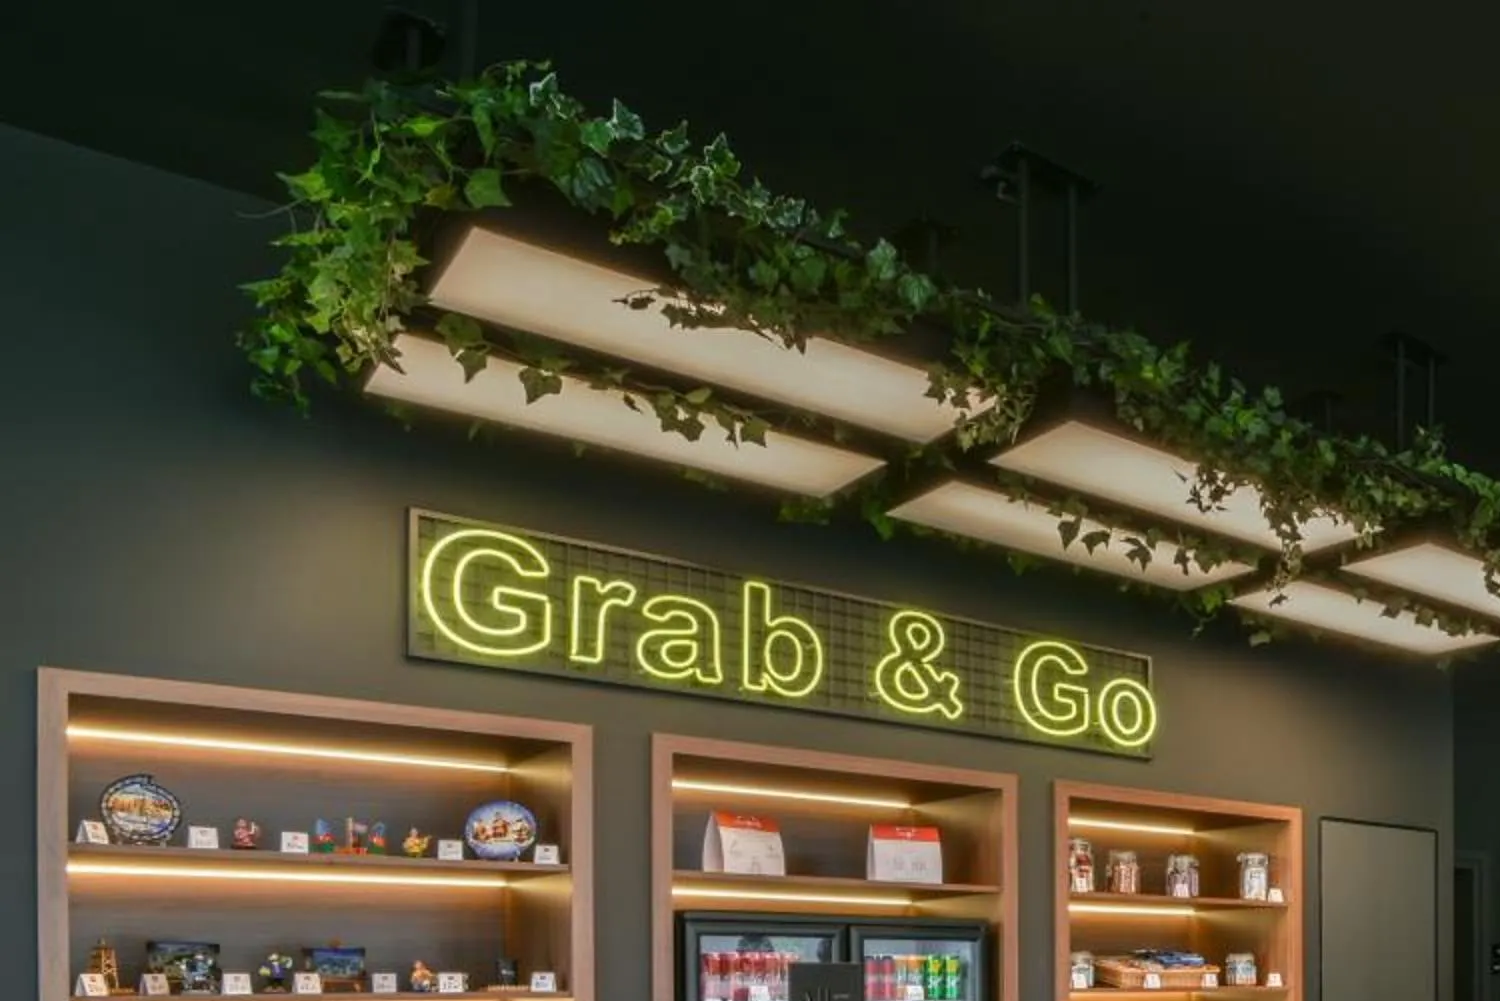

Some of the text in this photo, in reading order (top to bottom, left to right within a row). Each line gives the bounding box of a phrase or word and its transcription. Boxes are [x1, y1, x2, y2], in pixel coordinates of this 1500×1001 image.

[420, 528, 1158, 748] Grab & Go
